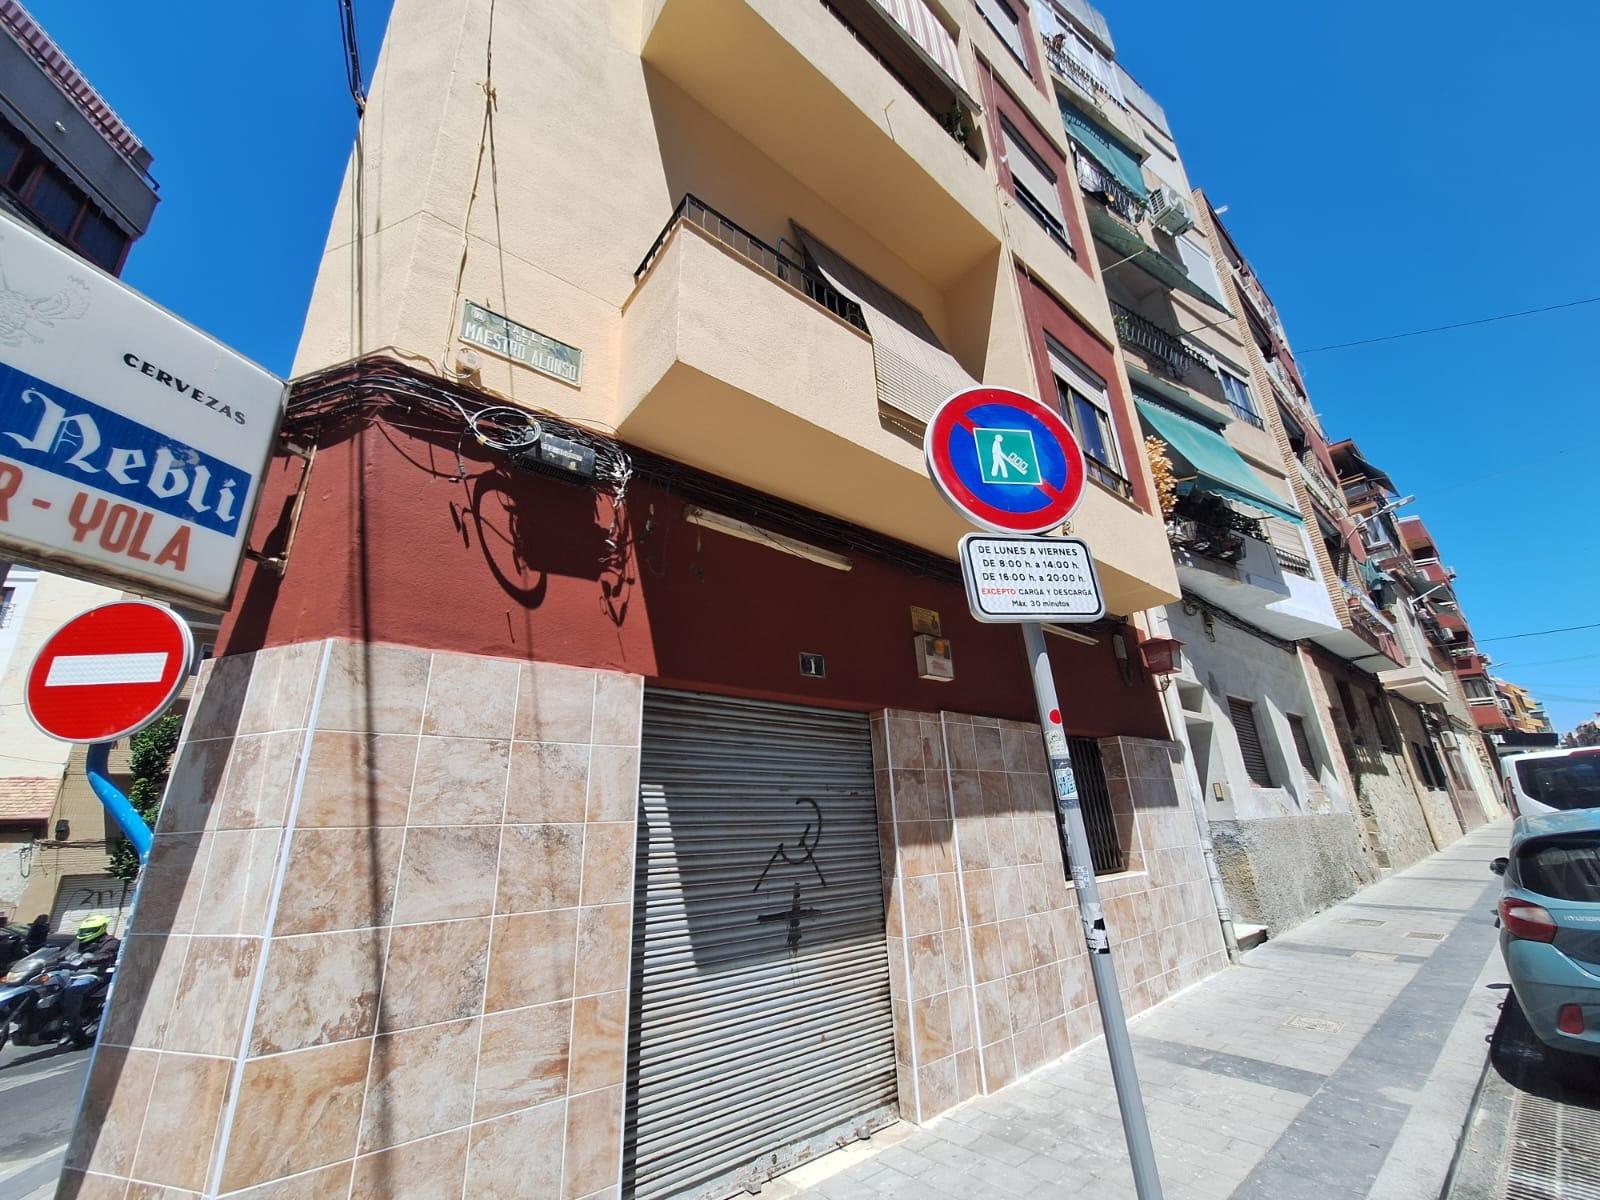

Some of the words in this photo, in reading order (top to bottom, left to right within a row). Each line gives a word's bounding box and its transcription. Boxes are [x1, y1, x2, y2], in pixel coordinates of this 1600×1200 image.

[502, 319, 550, 346] CALLE
[464, 321, 526, 360] MAESTRO
[531, 350, 577, 381] ALONSO
[123, 352, 246, 426] CERVEZAS
[68, 492, 192, 572] YOLA
[978, 545, 991, 554] DE
[994, 546, 1026, 555] LUNES
[1029, 547, 1036, 555] A
[1038, 547, 1078, 556] VIERNES
[982, 559, 997, 568] DE
[999, 559, 1022, 568] 8:00
[1043, 560, 1069, 569] 14:00
[982, 572, 997, 581] DE
[998, 573, 1026, 582] 16:00
[1046, 573, 1076, 582] 20:00
[1018, 588, 1045, 596] CARGA
[1053, 588, 1093, 596] DESCARGA
[1042, 599, 1070, 607] minutos
